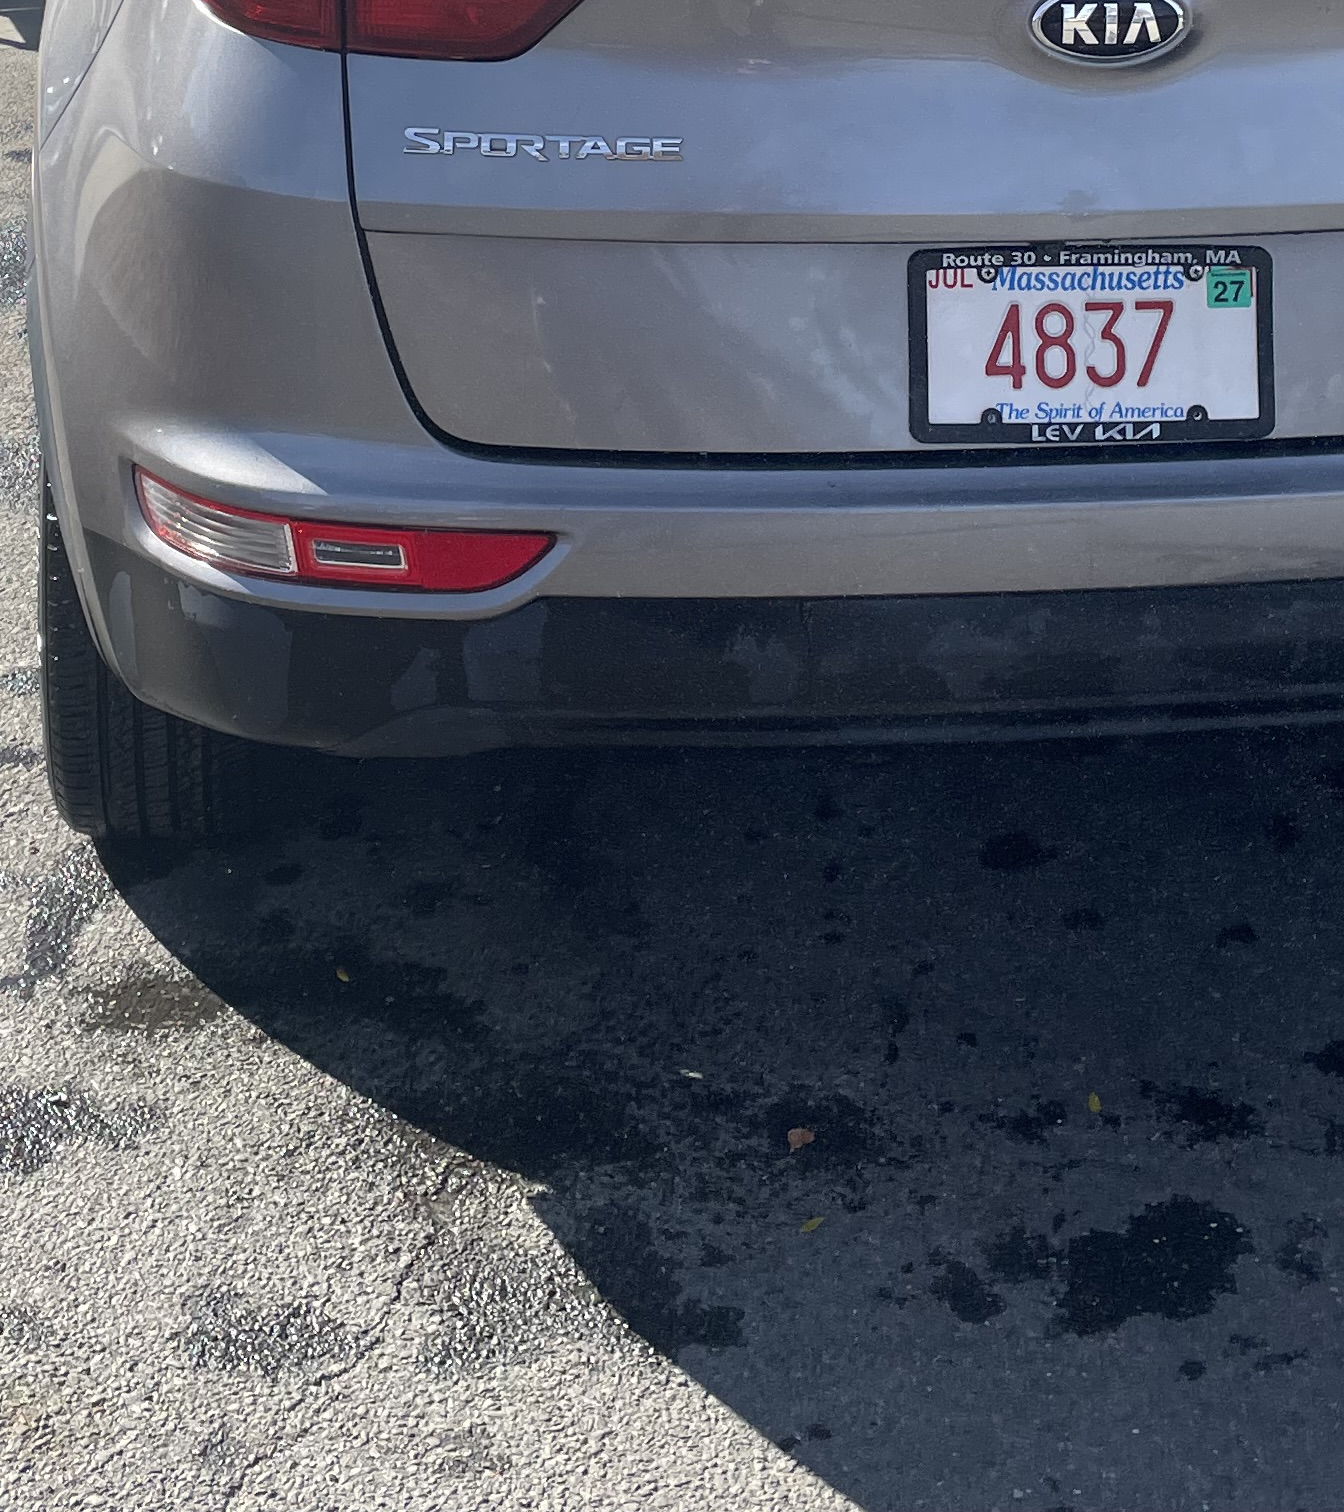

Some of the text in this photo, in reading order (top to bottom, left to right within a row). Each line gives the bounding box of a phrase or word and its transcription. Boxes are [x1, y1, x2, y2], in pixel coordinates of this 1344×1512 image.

[1060, 1, 1162, 45] KIA
[402, 126, 684, 163] SPORTAGE
[942, 248, 1242, 267] Route 30 Framingham, MA
[928, 268, 973, 289] JUL
[991, 265, 1185, 292] Massachusetts
[1213, 280, 1246, 303] 27
[985, 299, 1174, 390] 4837
[995, 401, 1184, 423] The Spirit of America
[1031, 422, 1161, 442] LEV KIA
